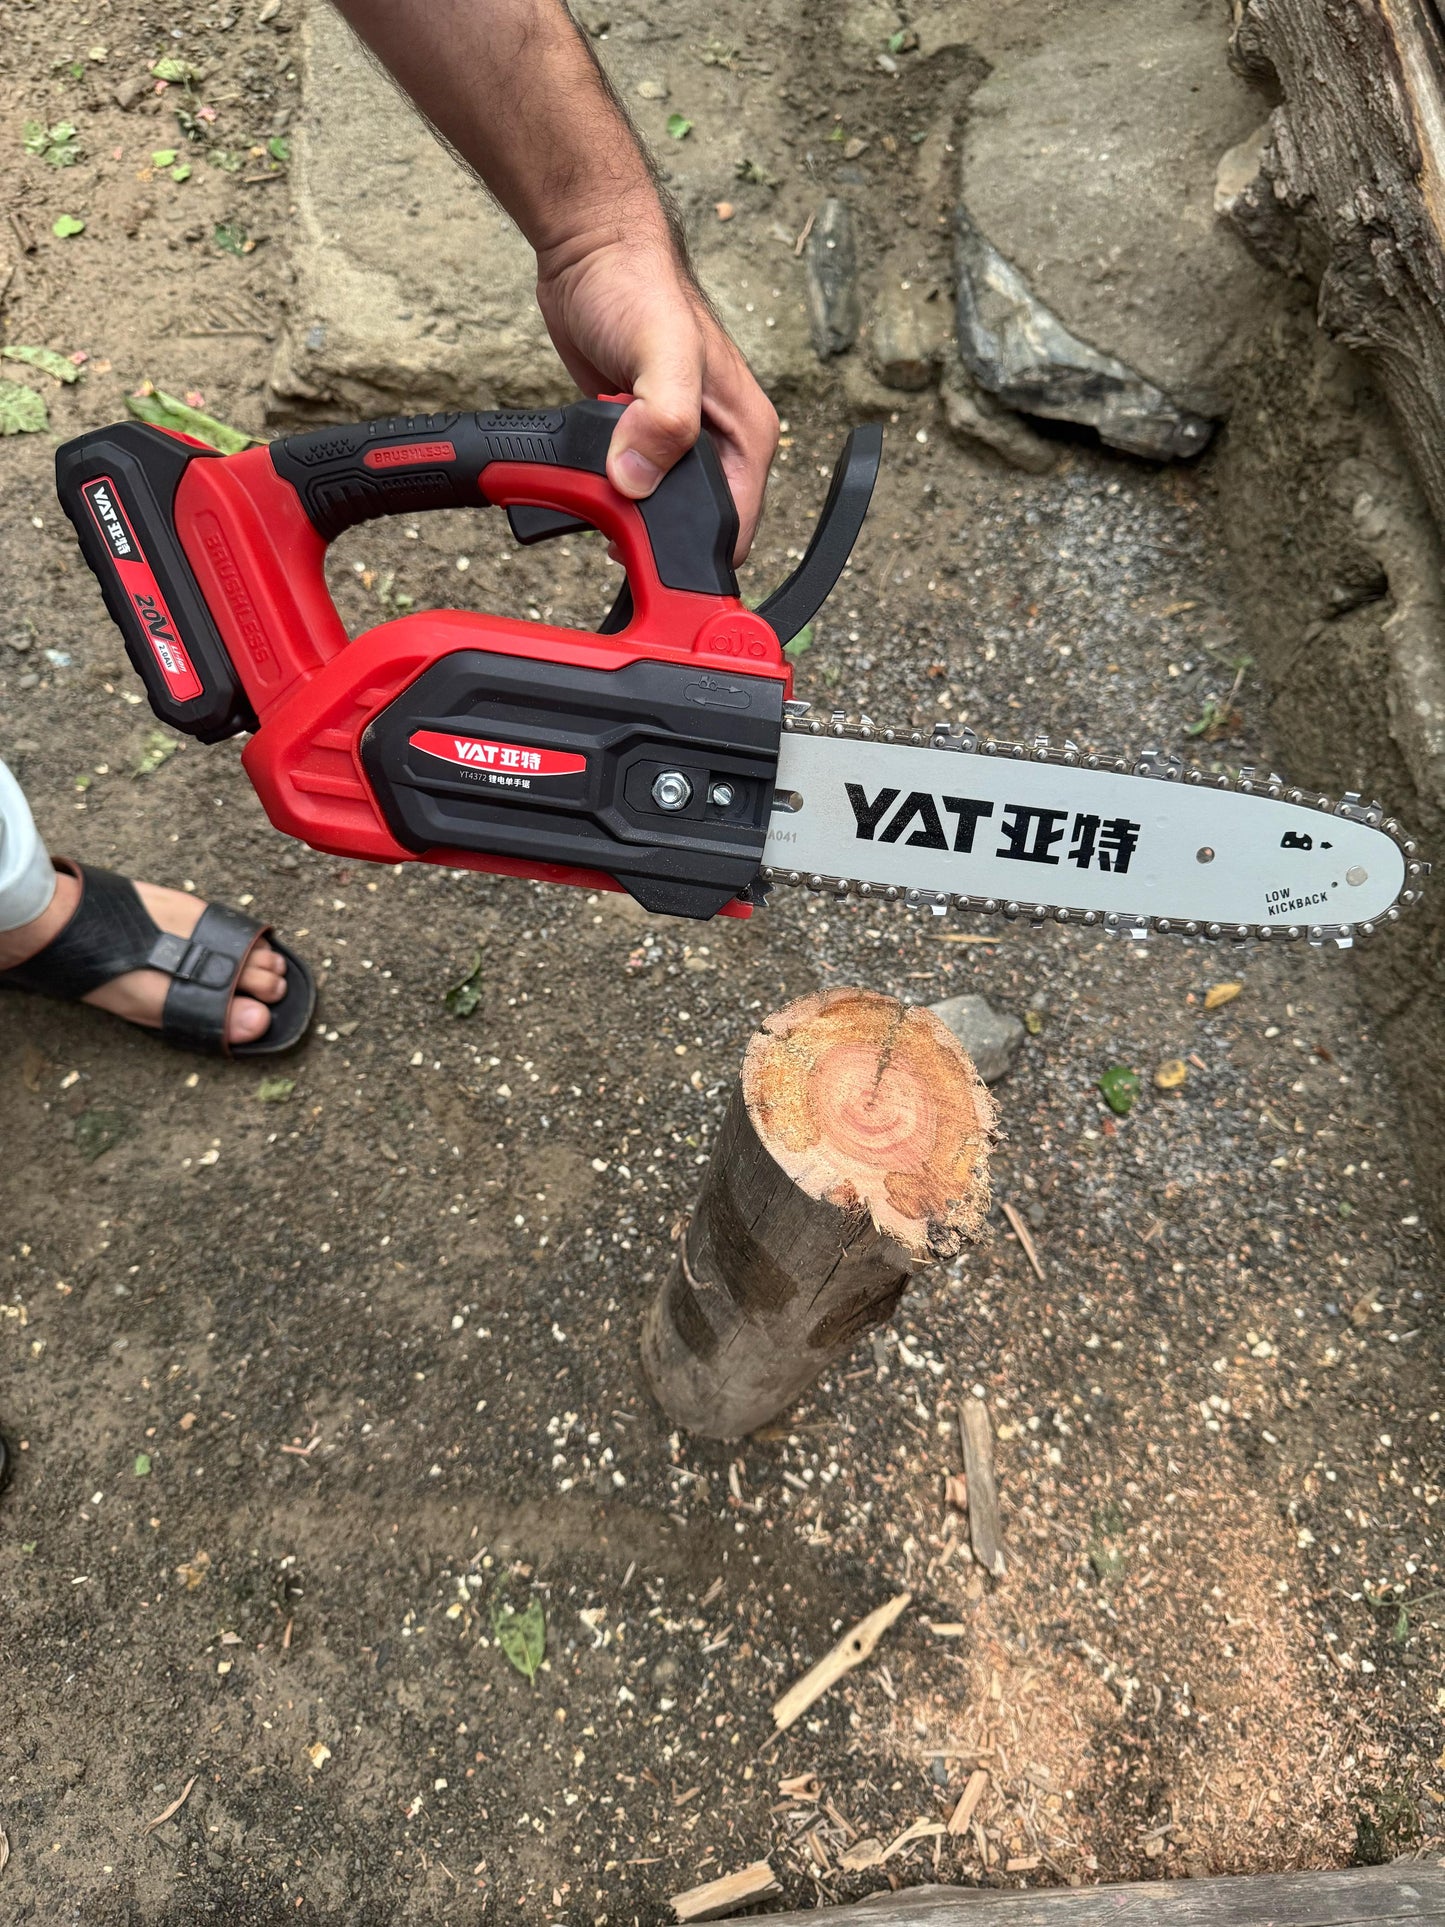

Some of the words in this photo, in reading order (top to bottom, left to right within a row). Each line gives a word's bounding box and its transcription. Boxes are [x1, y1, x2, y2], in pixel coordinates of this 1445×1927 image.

[374, 445, 450, 463] BRUSHLESS
[94, 486, 118, 521] YAT
[107, 521, 131, 555] 亚特
[206, 532, 270, 664] BRUSHLESS
[133, 593, 175, 642] 20V
[158, 644, 172, 668] 2.0Ah
[454, 740, 499, 763] YAT
[500, 748, 541, 770] 亚特
[460, 771, 487, 782] YT4372
[488, 774, 530, 789] 锂电单手锯
[844, 782, 994, 853] YAT
[996, 803, 1141, 874] 亚特
[1265, 888, 1290, 903] LOW
[1267, 892, 1328, 916] KICKBACK
